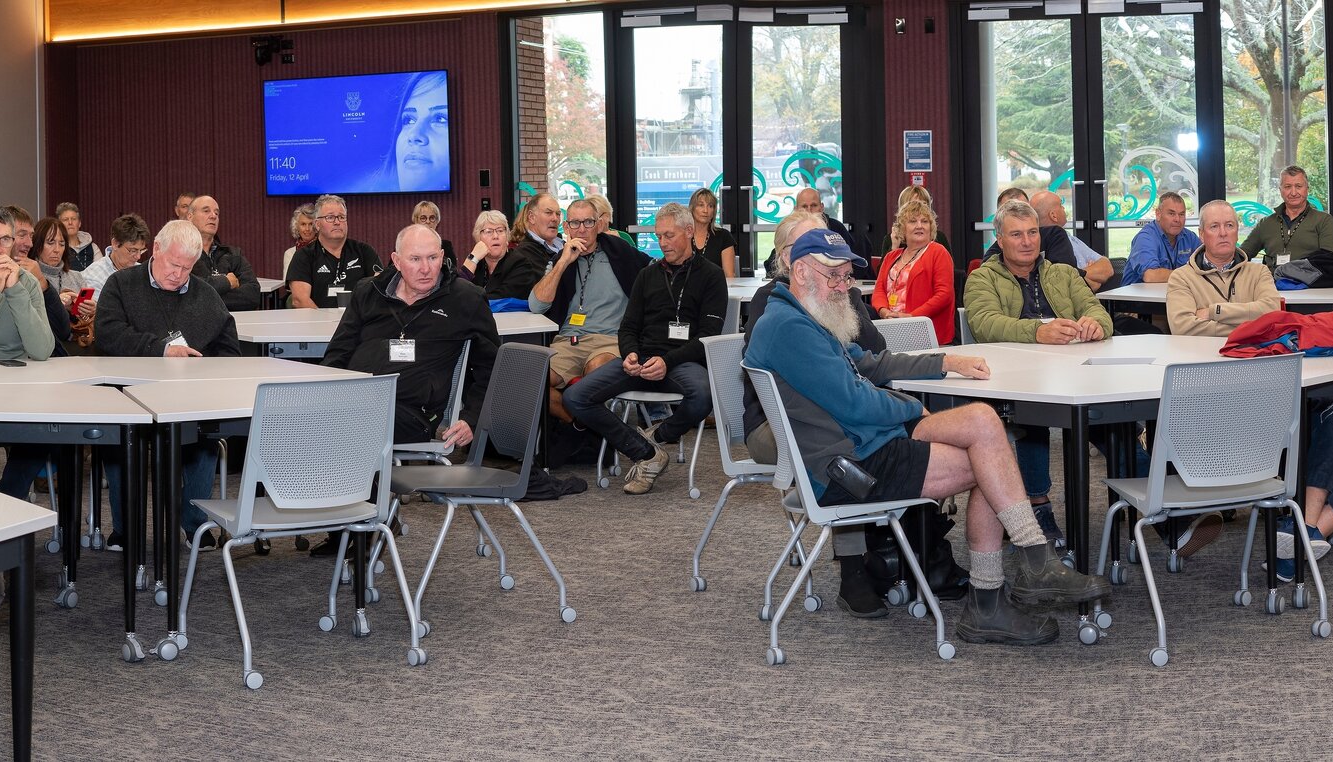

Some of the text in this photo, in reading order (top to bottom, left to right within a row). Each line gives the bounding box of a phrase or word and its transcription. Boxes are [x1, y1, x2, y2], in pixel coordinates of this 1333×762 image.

[269, 156, 296, 170] 11:40
[269, 174, 288, 183] Friday,
[296, 173, 309, 182] April
